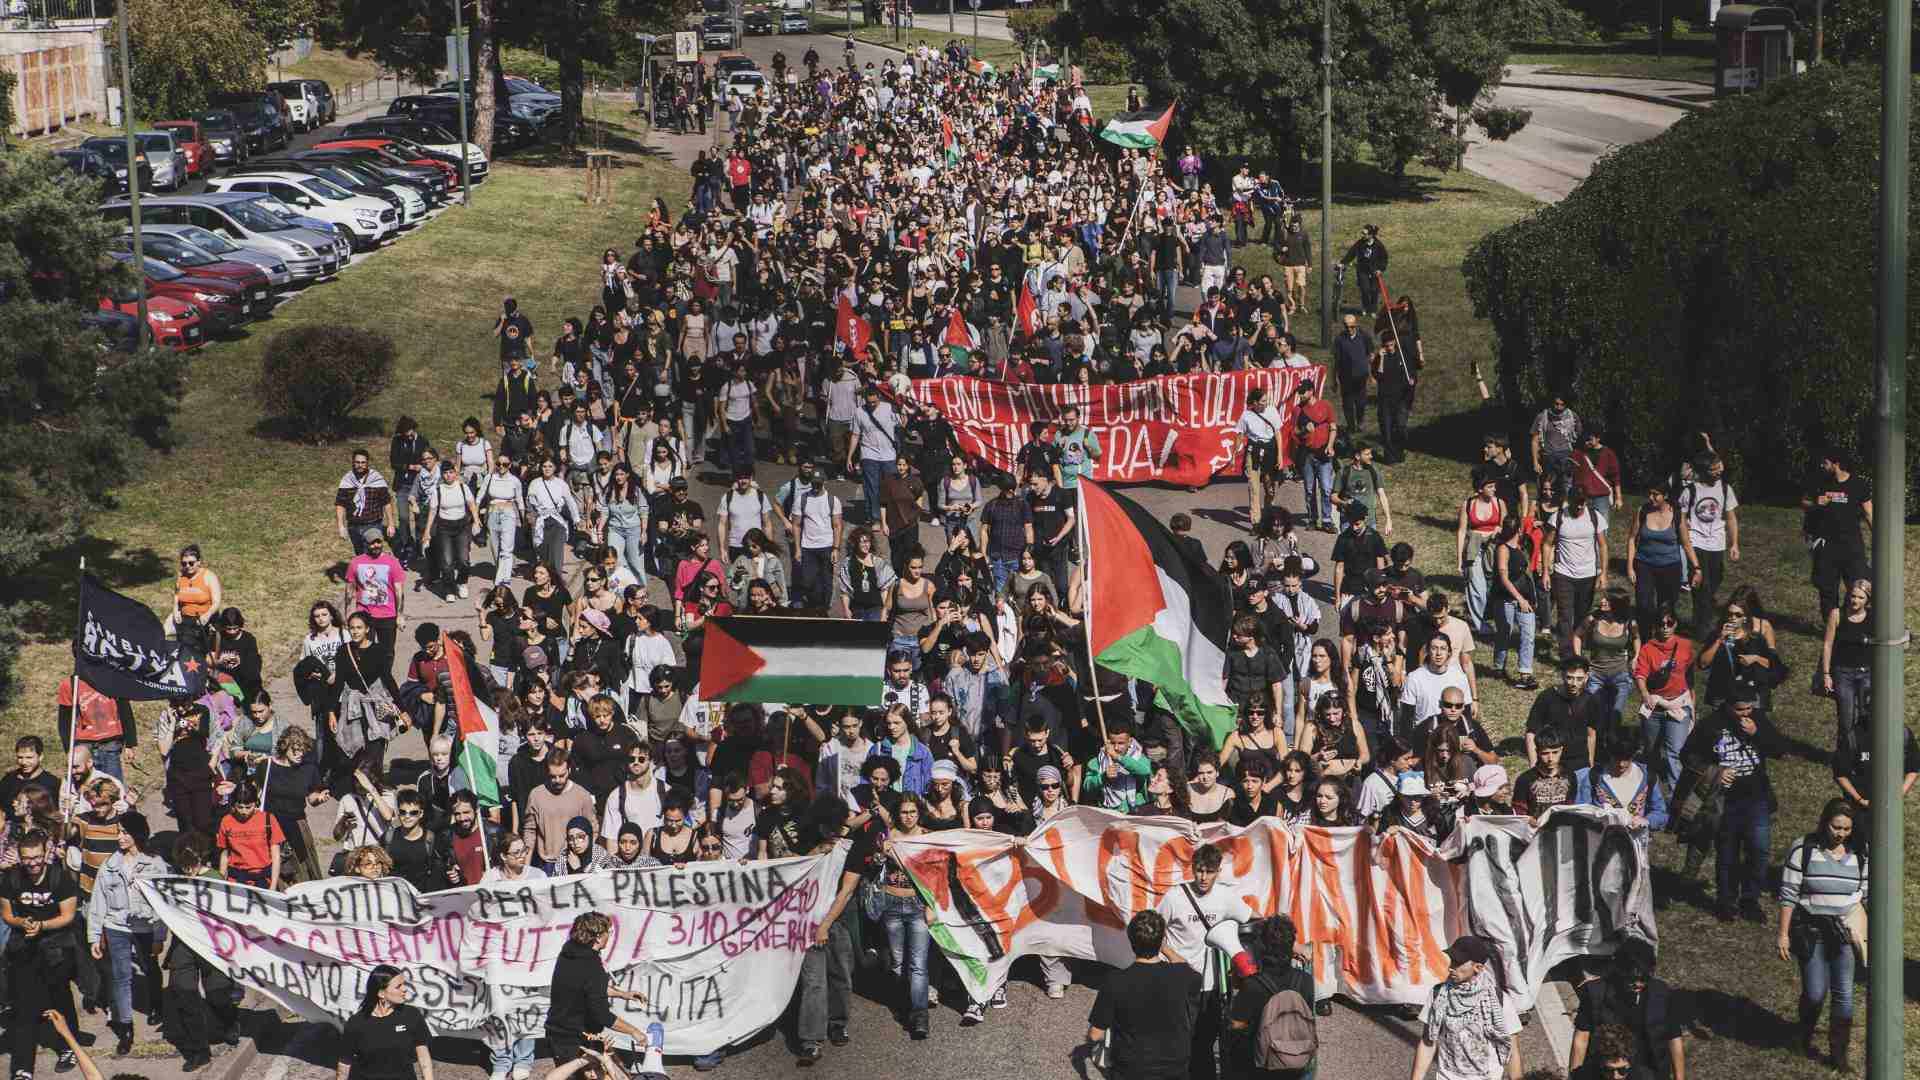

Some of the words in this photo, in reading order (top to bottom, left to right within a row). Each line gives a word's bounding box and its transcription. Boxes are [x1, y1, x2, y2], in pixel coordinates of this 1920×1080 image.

[1204, 374, 1237, 427] DEL
[224, 882, 267, 916] LA
[475, 886, 538, 918] PER
[551, 880, 598, 909] LA
[614, 865, 788, 908] PALESTINA
[667, 910, 729, 946] 3/10
